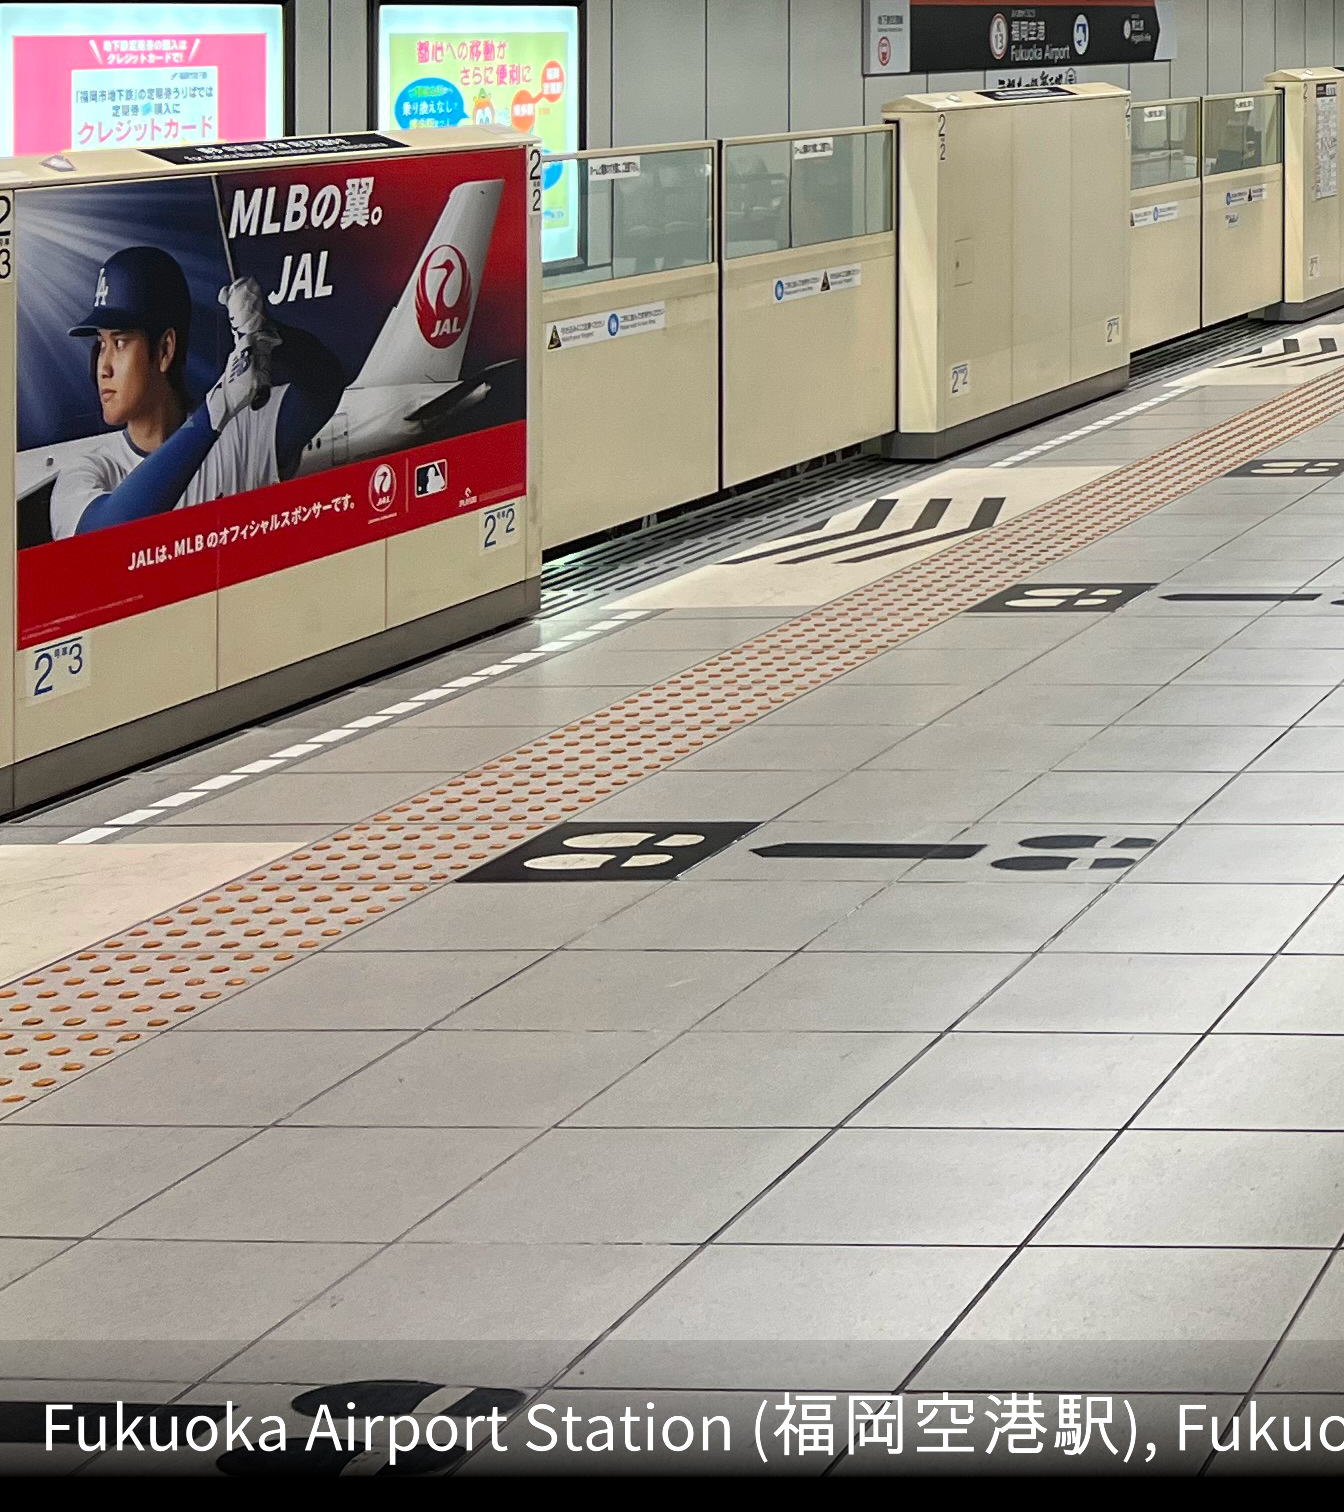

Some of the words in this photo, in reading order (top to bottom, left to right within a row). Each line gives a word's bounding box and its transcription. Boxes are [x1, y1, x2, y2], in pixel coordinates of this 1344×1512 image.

[416, 40, 508, 64] 都心への移動が
[1010, 44, 1042, 61] Fukuoka
[1044, 44, 1071, 63] Airport
[460, 64, 533, 86] さらに便利に
[77, 116, 214, 145] クレジットカード
[937, 113, 946, 137] 2
[939, 142, 946, 161] 2
[529, 149, 541, 181] 2
[228, 176, 383, 239] MLBの翼。
[532, 188, 541, 212] 2
[267, 250, 333, 306] JAL
[430, 316, 462, 338] JAL
